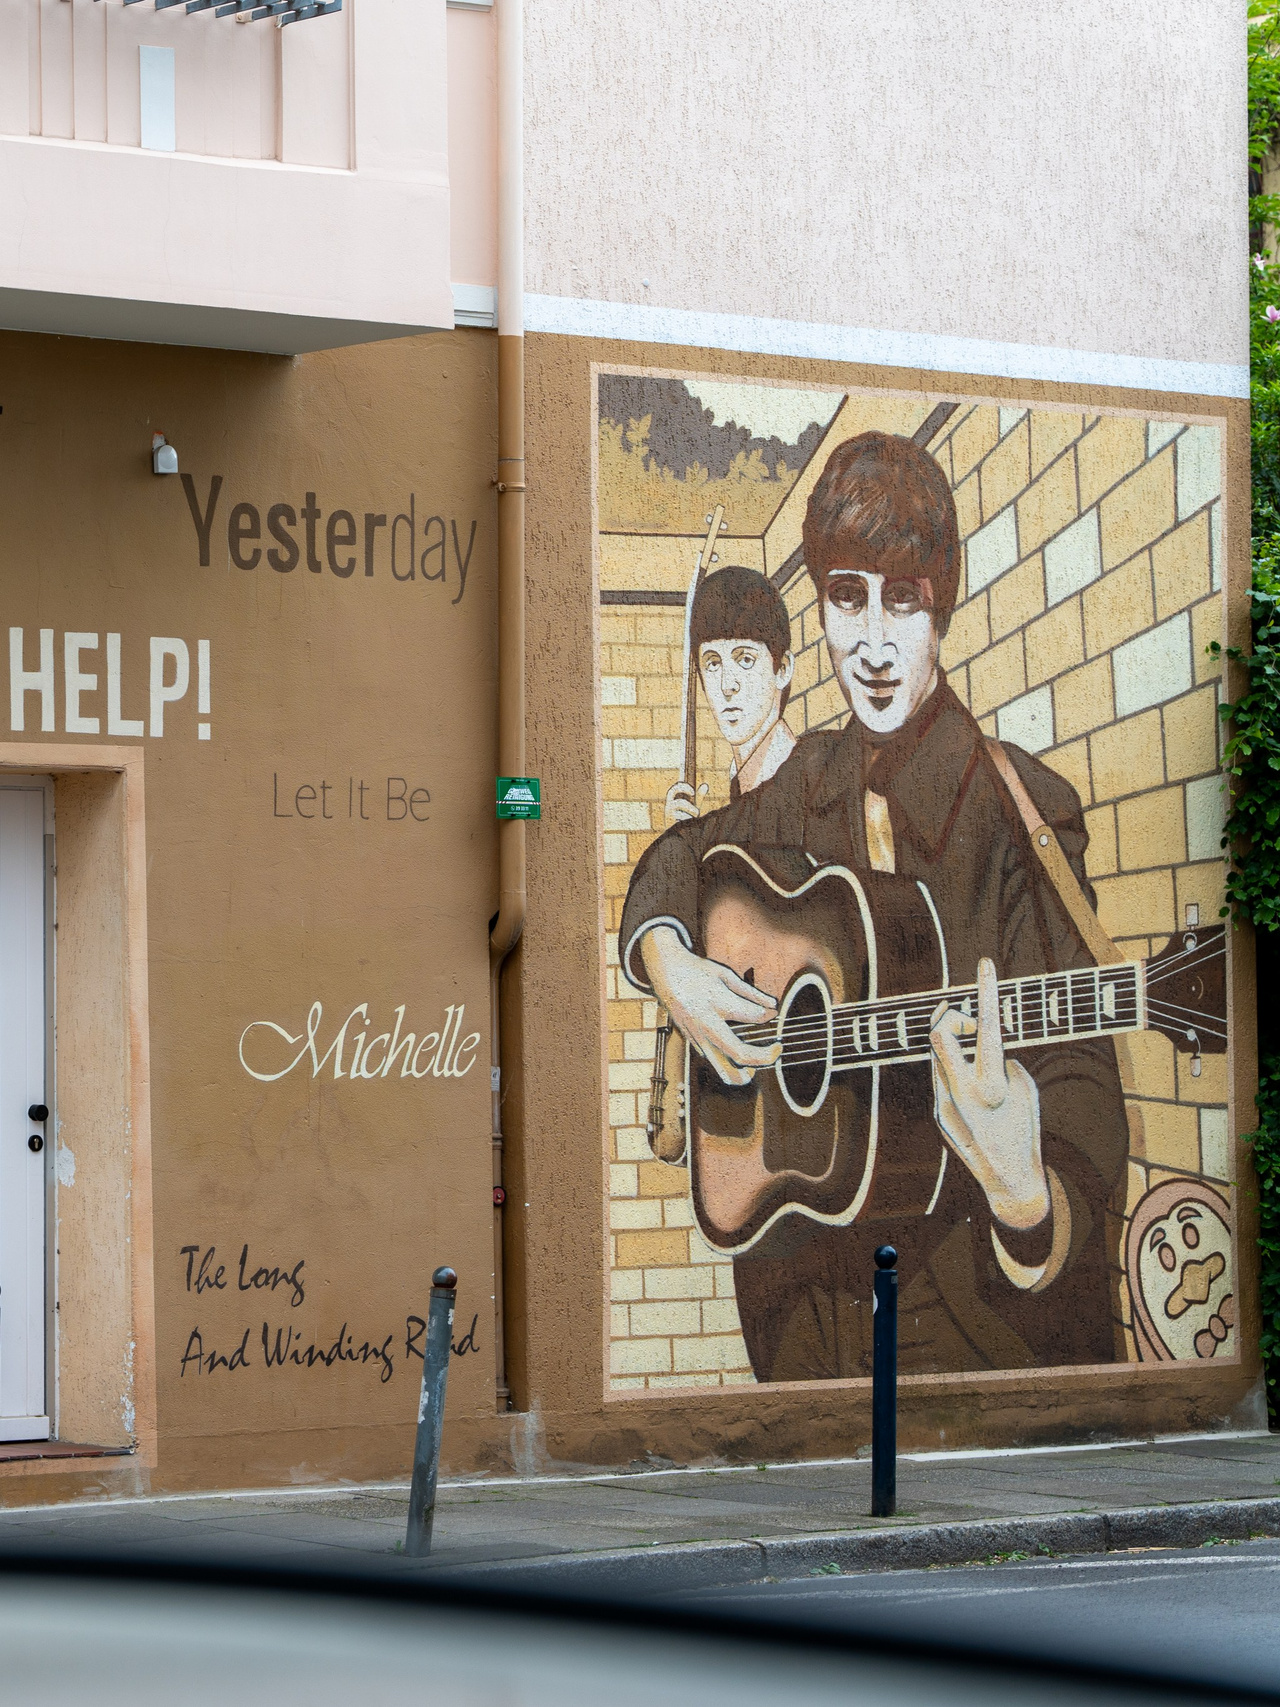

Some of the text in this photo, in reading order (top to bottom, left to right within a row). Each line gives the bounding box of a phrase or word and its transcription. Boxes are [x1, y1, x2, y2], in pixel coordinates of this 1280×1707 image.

[180, 473, 478, 605] Yesterday
[9, 626, 212, 741] HELP!
[273, 772, 431, 822] Let It Be
[238, 1001, 481, 1082] Michelle
[180, 1243, 305, 1307] The Long
[180, 1313, 480, 1383] And Winding Rd
